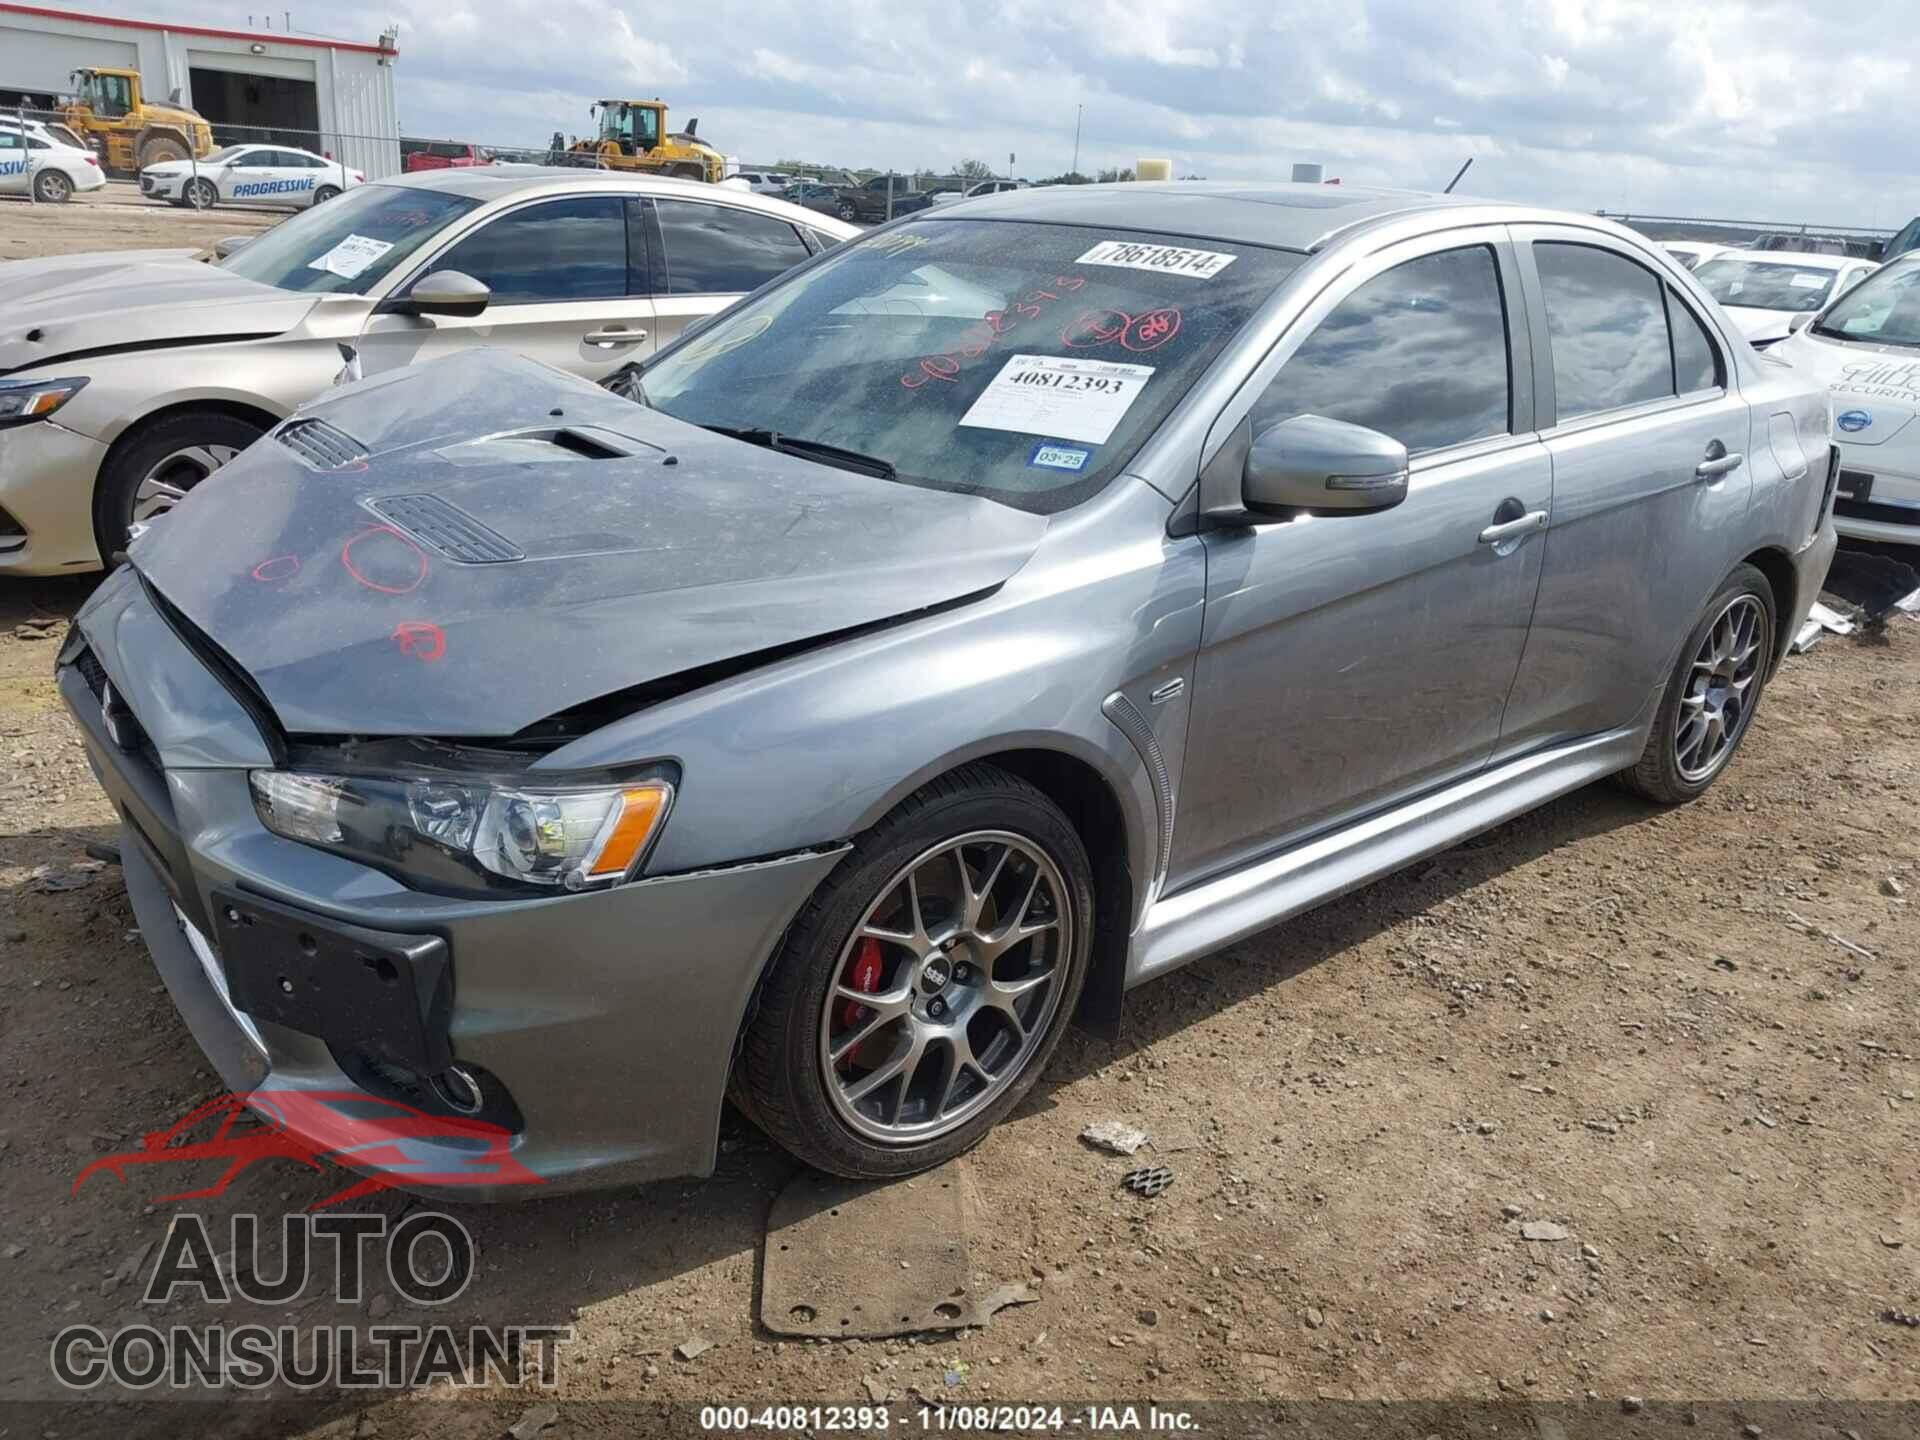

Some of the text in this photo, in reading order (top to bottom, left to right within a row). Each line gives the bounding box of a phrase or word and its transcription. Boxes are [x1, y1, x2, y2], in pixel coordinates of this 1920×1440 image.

[233, 178, 316, 197] PROGRESSIVE
[1102, 244, 1215, 271] 78618514
[1010, 370, 1123, 394] 40812393
